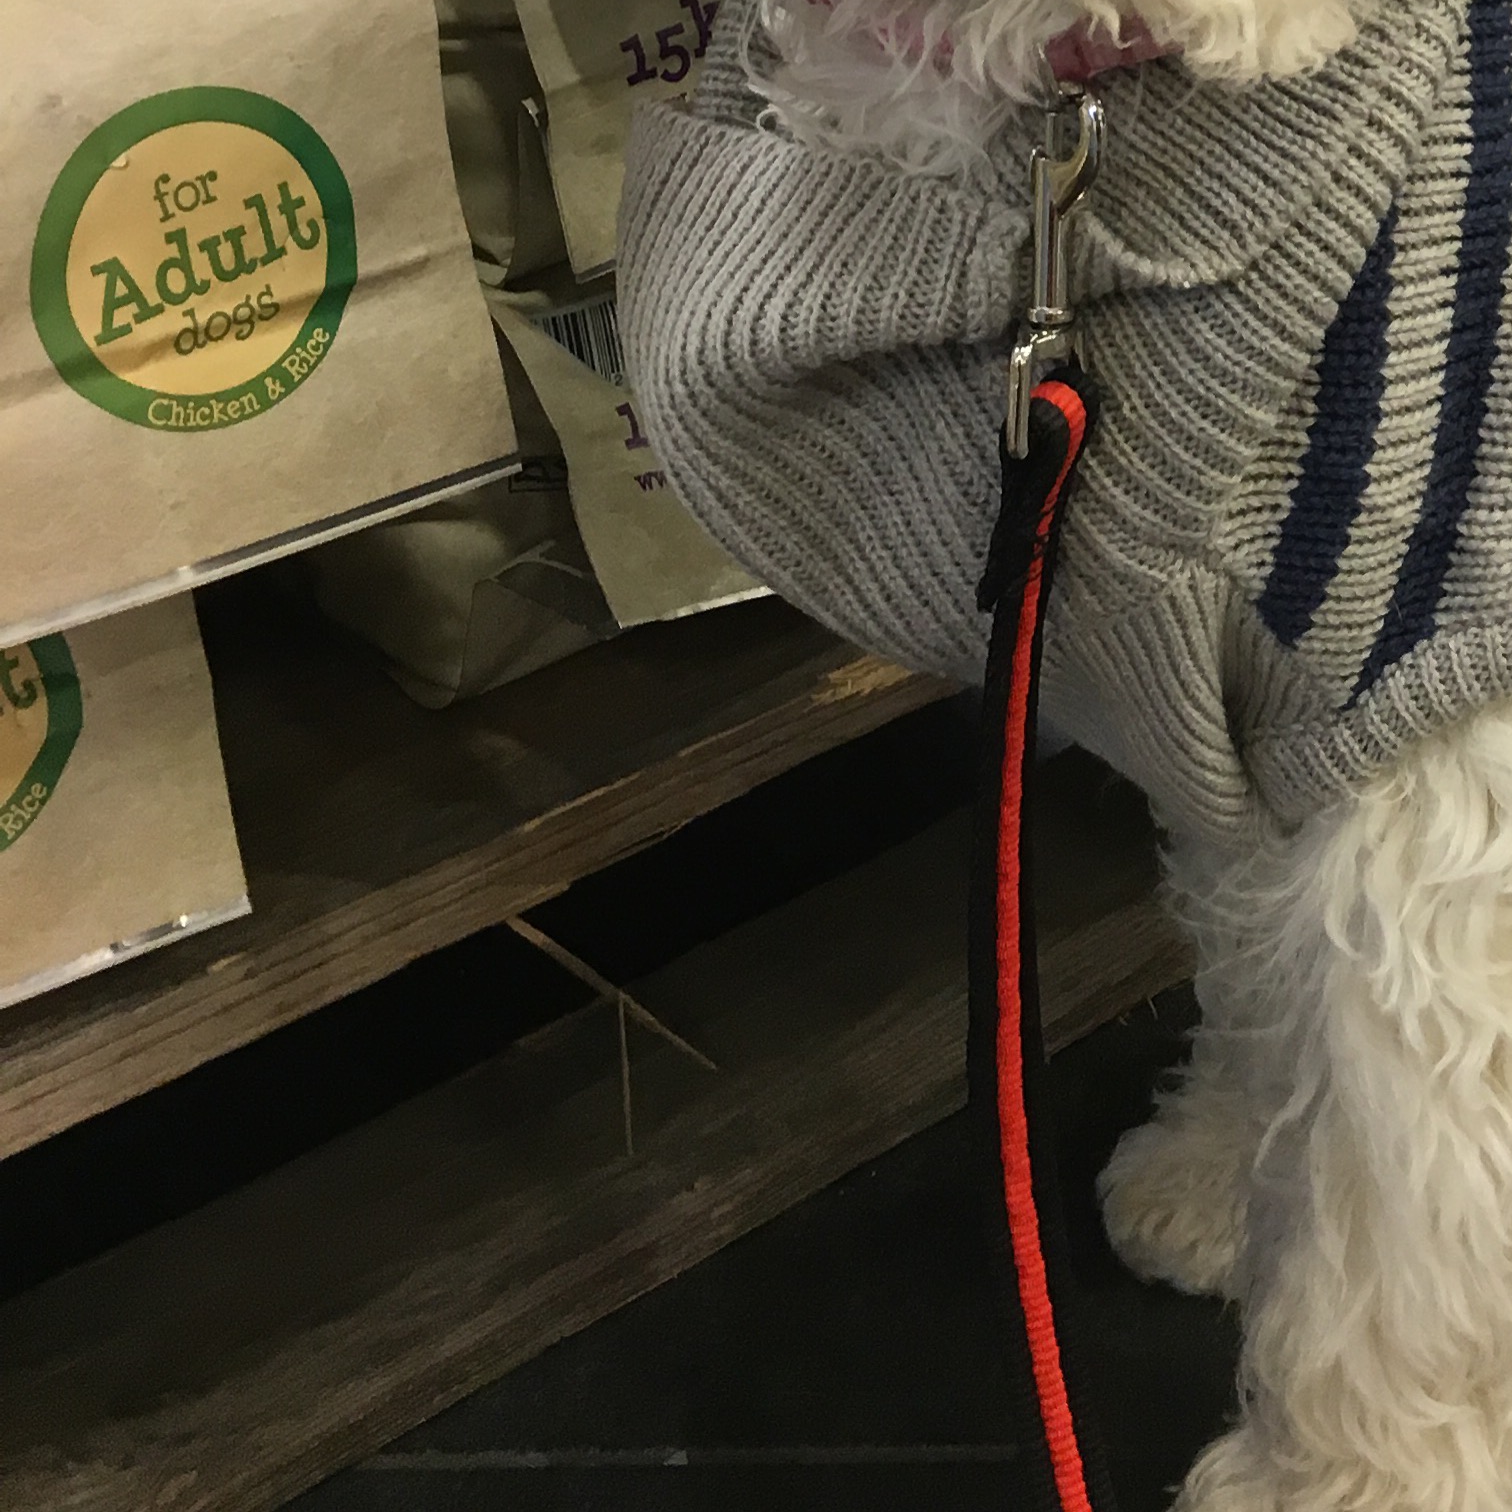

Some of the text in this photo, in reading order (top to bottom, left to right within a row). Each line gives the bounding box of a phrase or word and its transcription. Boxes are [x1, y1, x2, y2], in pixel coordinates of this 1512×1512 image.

[153, 170, 218, 223] for
[90, 181, 321, 347] Adult
[174, 284, 280, 356] dogs
[147, 327, 330, 427] Chicken & Rice
[0, 782, 47, 840] Rice
